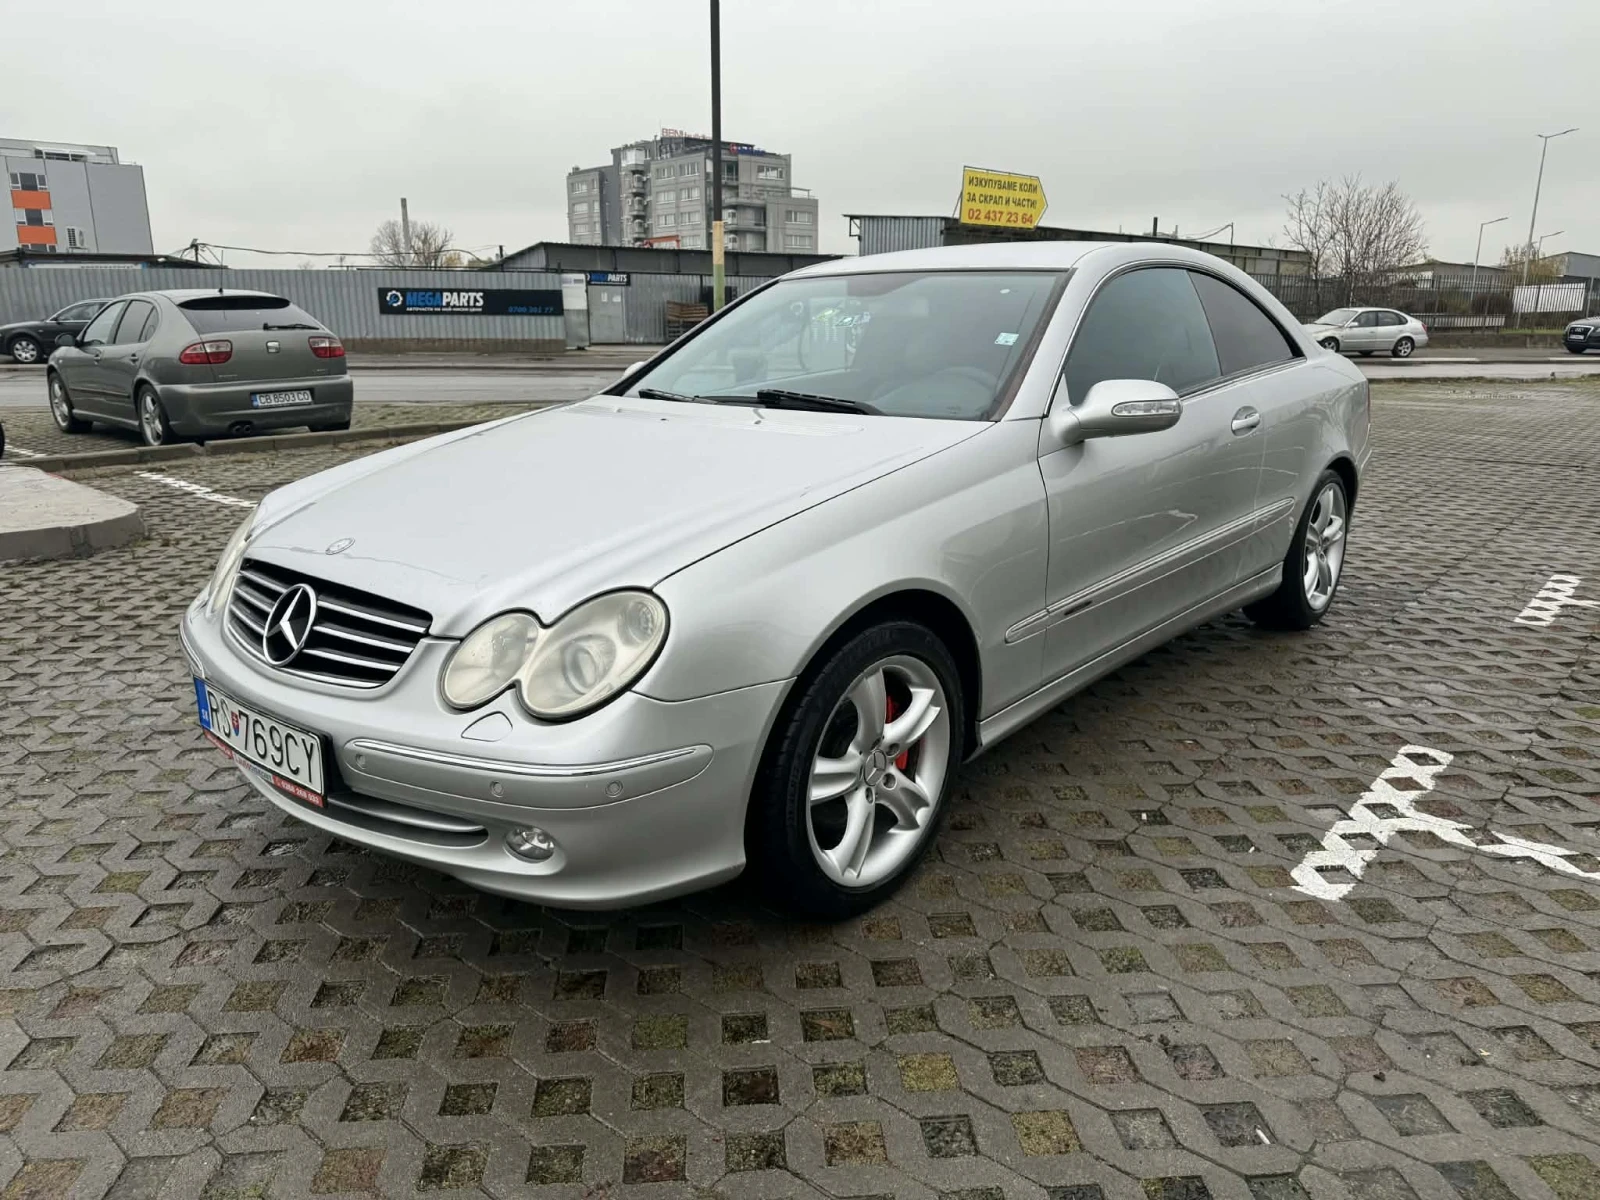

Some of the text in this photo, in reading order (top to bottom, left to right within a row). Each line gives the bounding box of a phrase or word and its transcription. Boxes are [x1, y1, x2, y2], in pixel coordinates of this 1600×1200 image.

[968, 176, 1038, 195] ИЗКУПУВАМЕ КОЛИ
[966, 192, 977, 203] ЗА
[978, 193, 1003, 206] СКРАП
[1004, 195, 1011, 206] И
[968, 208, 1034, 225] 02 437 23 64
[406, 292, 484, 307] MEGAPARTS
[259, 391, 310, 405] CB 8503 CO
[207, 690, 232, 739] RS
[239, 709, 314, 783] 769CY
